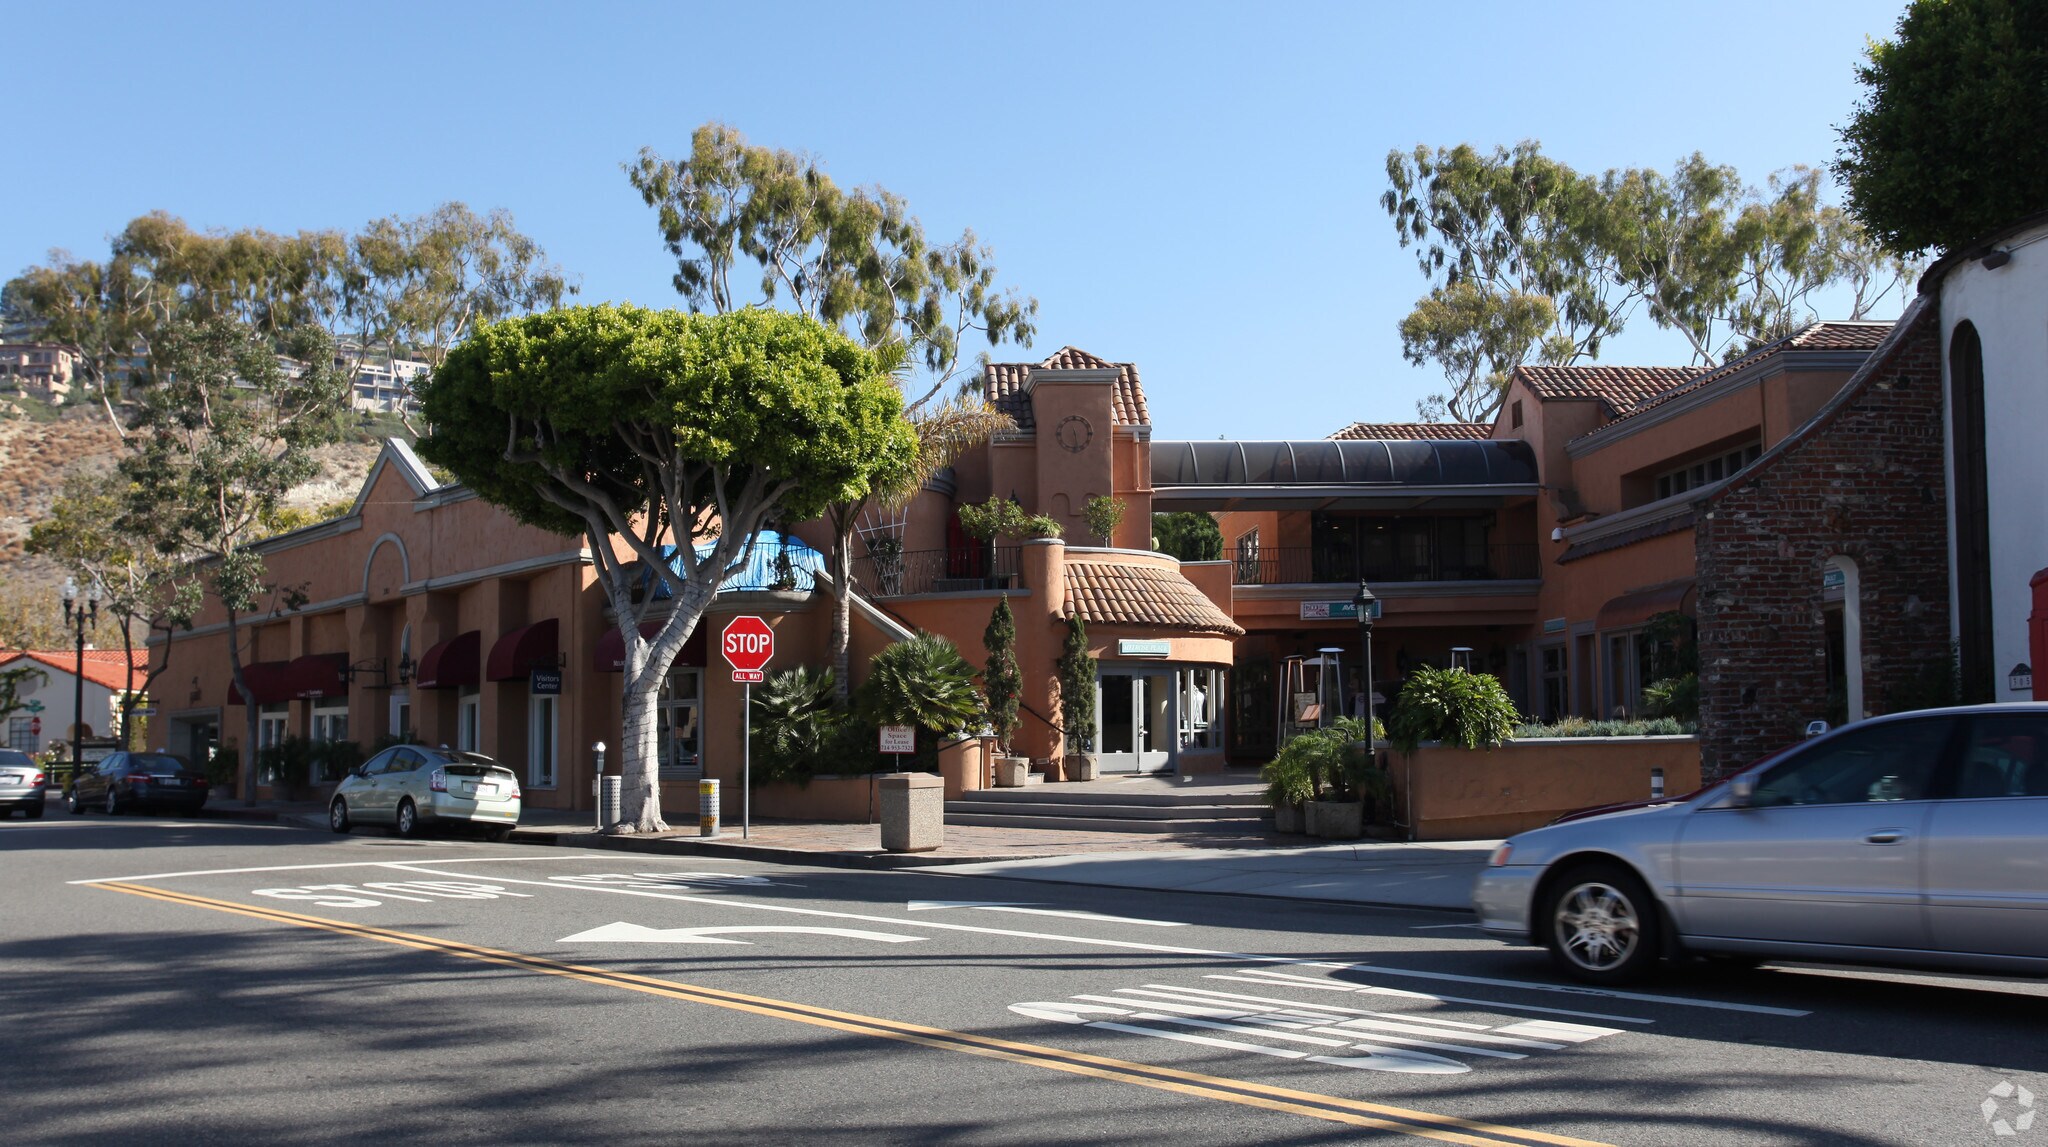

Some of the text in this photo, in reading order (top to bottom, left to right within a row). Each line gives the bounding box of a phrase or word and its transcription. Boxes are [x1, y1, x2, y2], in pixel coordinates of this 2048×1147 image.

[726, 633, 770, 654] STOP
[536, 674, 560, 682] Visitors
[537, 682, 558, 690] Center
[251, 880, 535, 908] STOP
